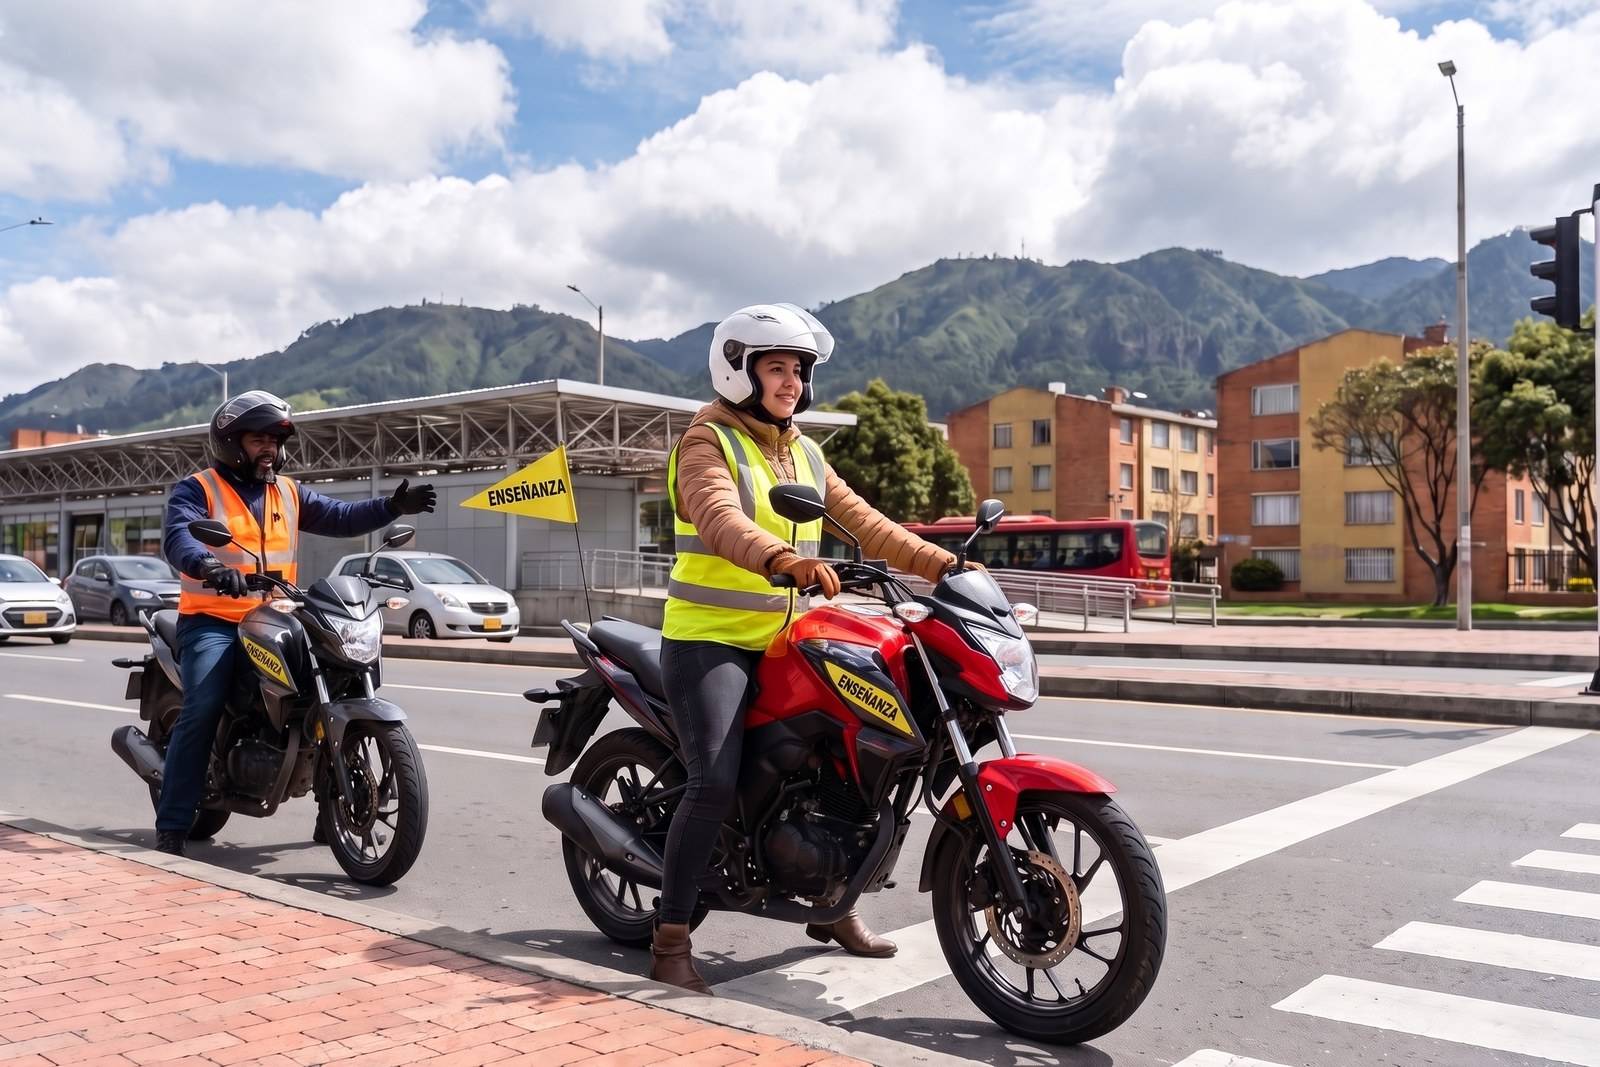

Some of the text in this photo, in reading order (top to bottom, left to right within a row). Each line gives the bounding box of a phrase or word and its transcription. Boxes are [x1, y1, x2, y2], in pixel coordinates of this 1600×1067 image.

[487, 479, 566, 506] ENSEÑANZA
[246, 643, 282, 676] ENSEÑANZA
[838, 674, 898, 721] ENSEÑANZA
